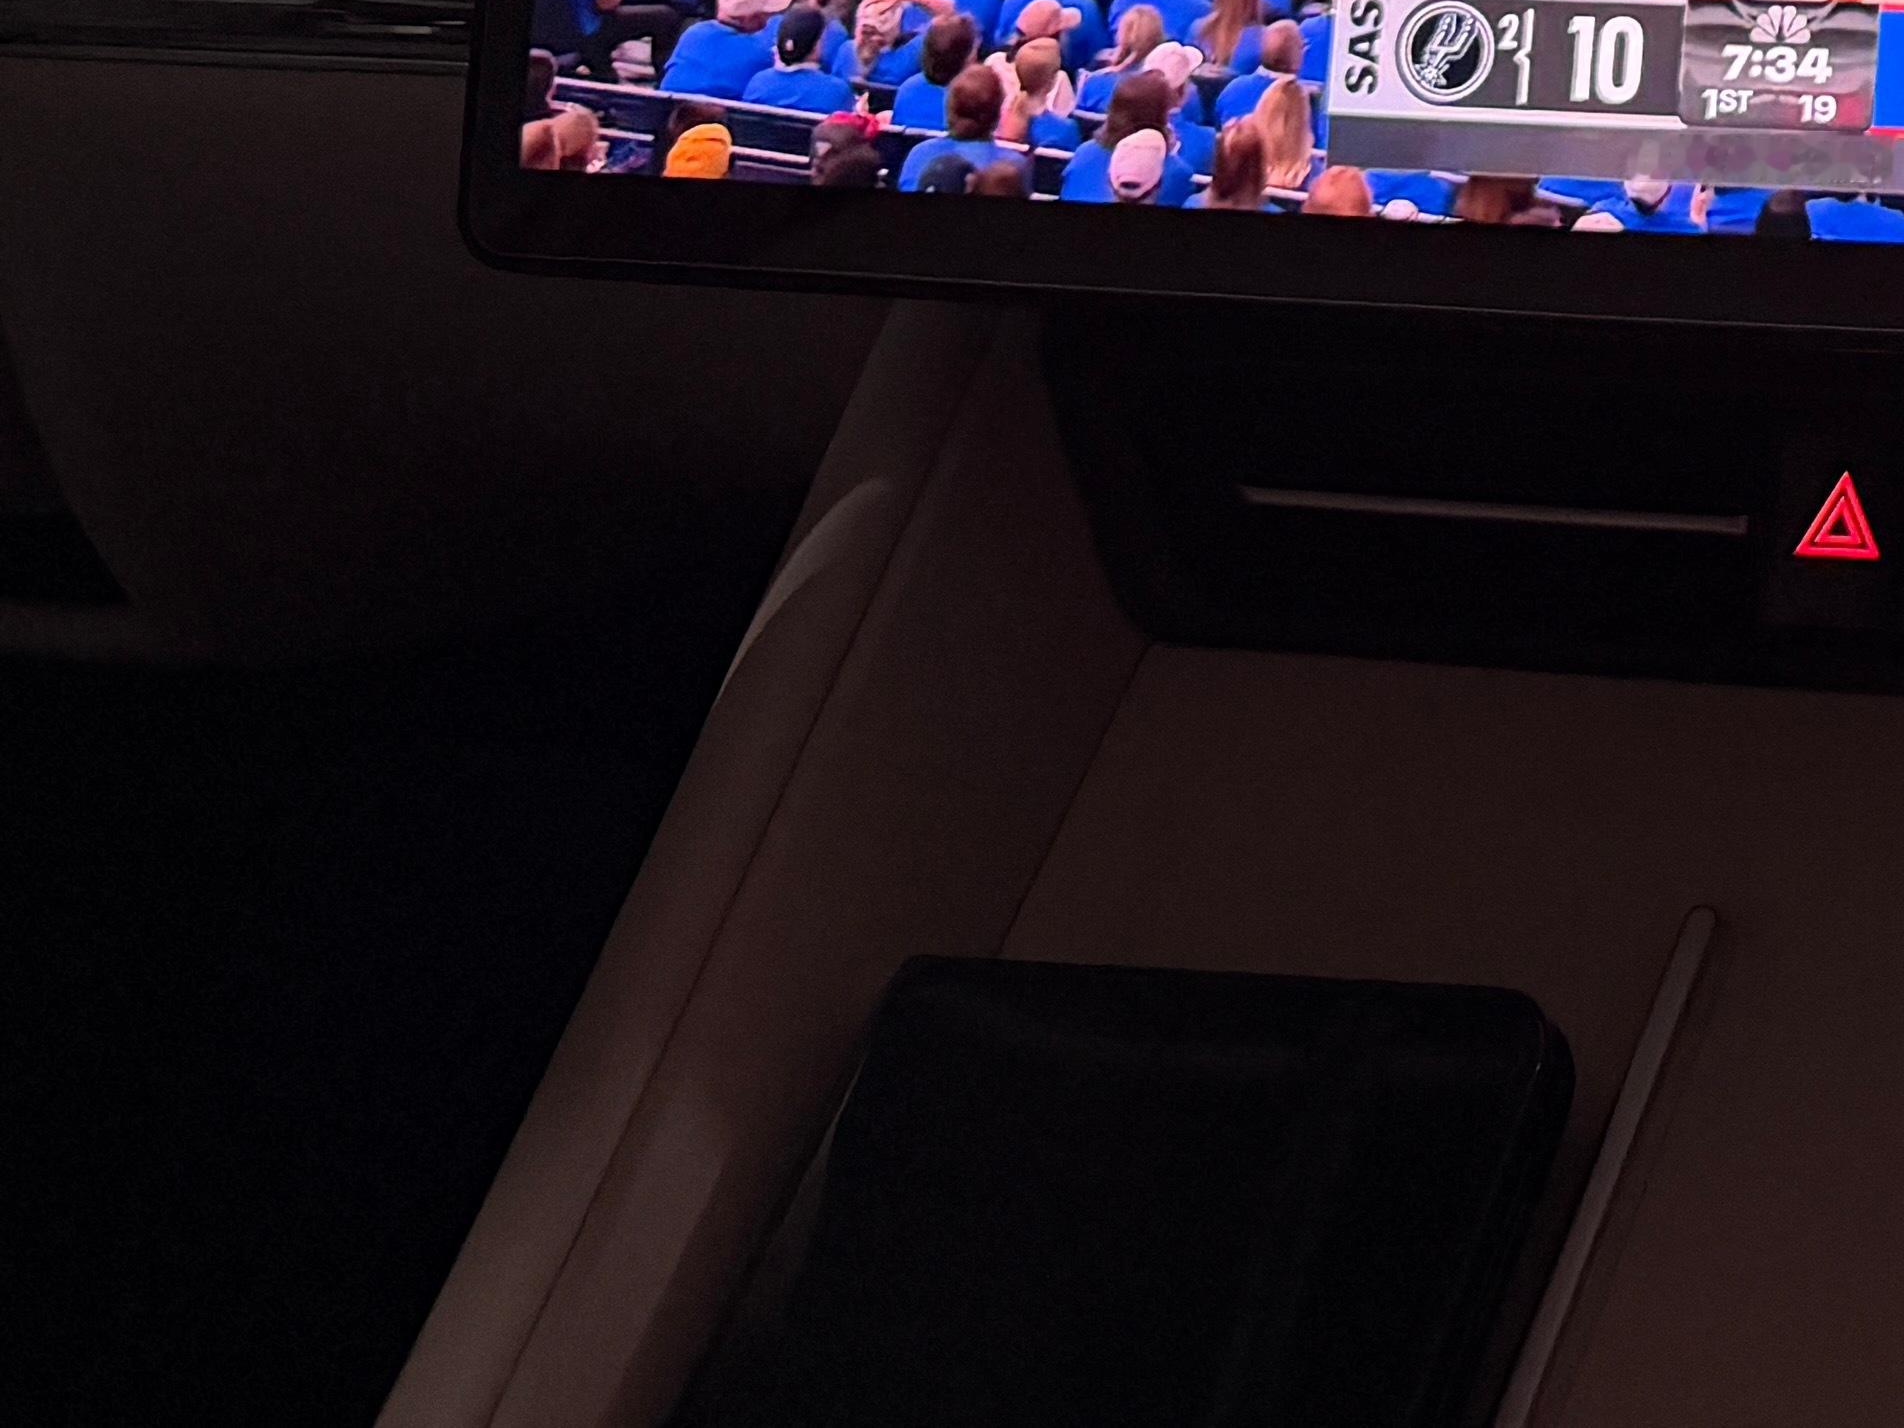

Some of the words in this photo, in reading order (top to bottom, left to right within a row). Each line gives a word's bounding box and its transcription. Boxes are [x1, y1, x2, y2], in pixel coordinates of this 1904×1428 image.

[1496, 13, 1520, 50] 2
[1566, 14, 1645, 105] 10
[1720, 44, 1833, 85] 7:34
[1701, 87, 1754, 120] 1ST
[1798, 94, 1838, 124] 19
